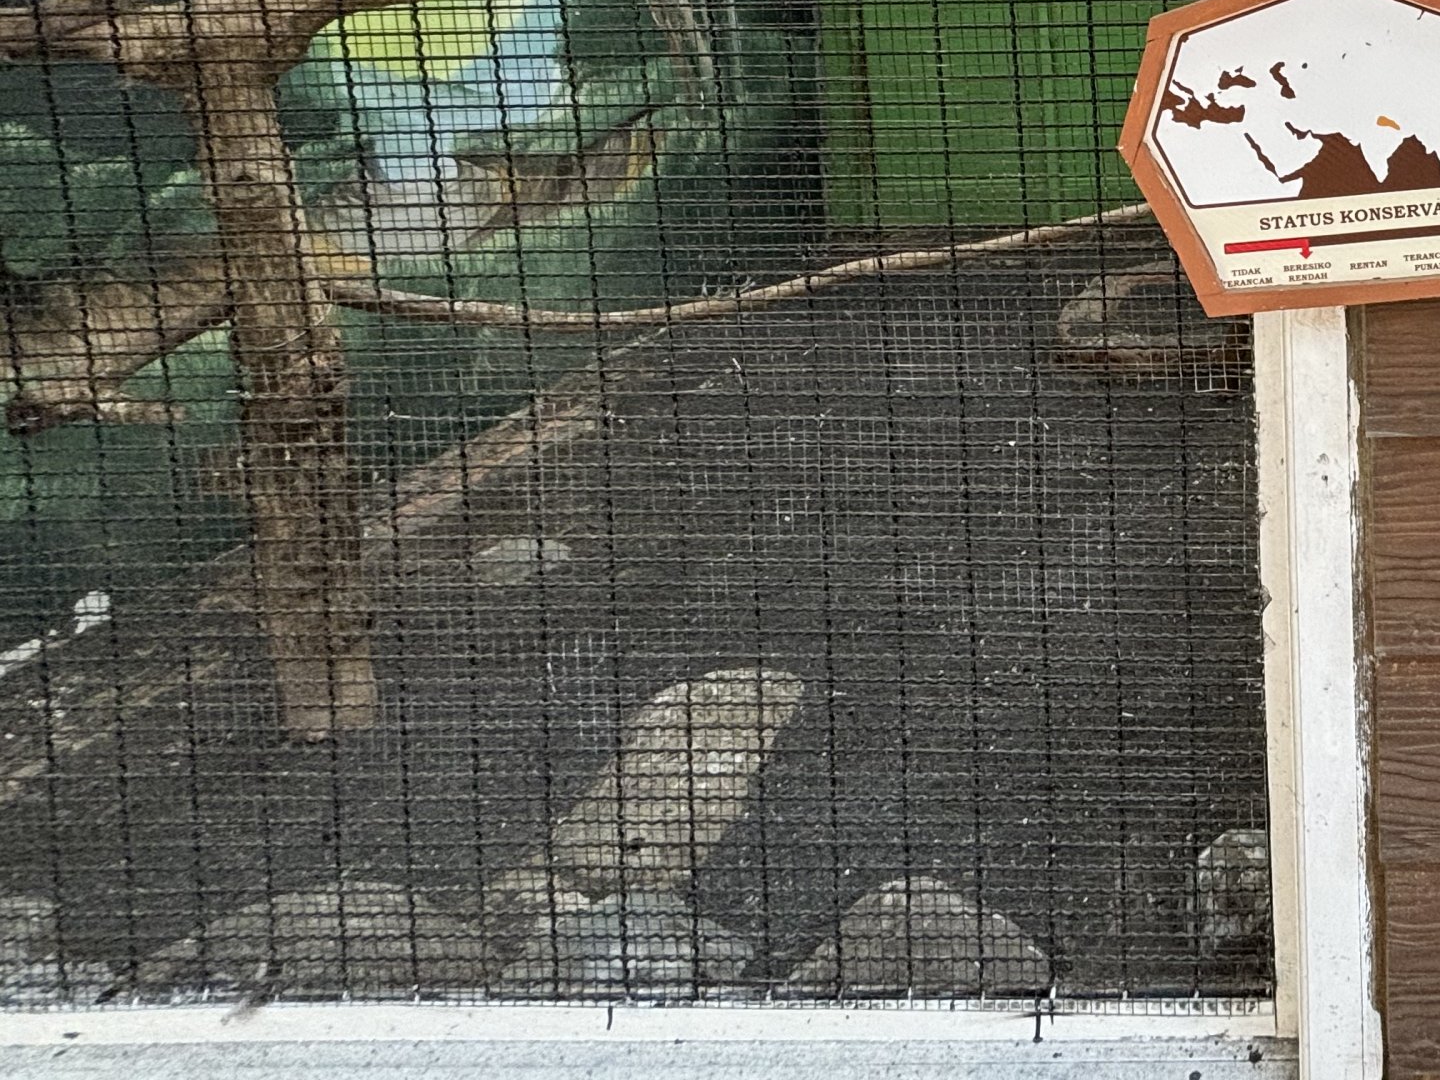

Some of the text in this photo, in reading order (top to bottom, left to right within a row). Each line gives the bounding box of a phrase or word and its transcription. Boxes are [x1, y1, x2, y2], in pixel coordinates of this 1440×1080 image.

[1259, 212, 1334, 231] STATUS
[1283, 262, 1332, 272] BERESIKO
[1350, 260, 1388, 270] RENTAN
[1231, 268, 1261, 277] TIDAK
[1288, 273, 1328, 282] RENDAH
